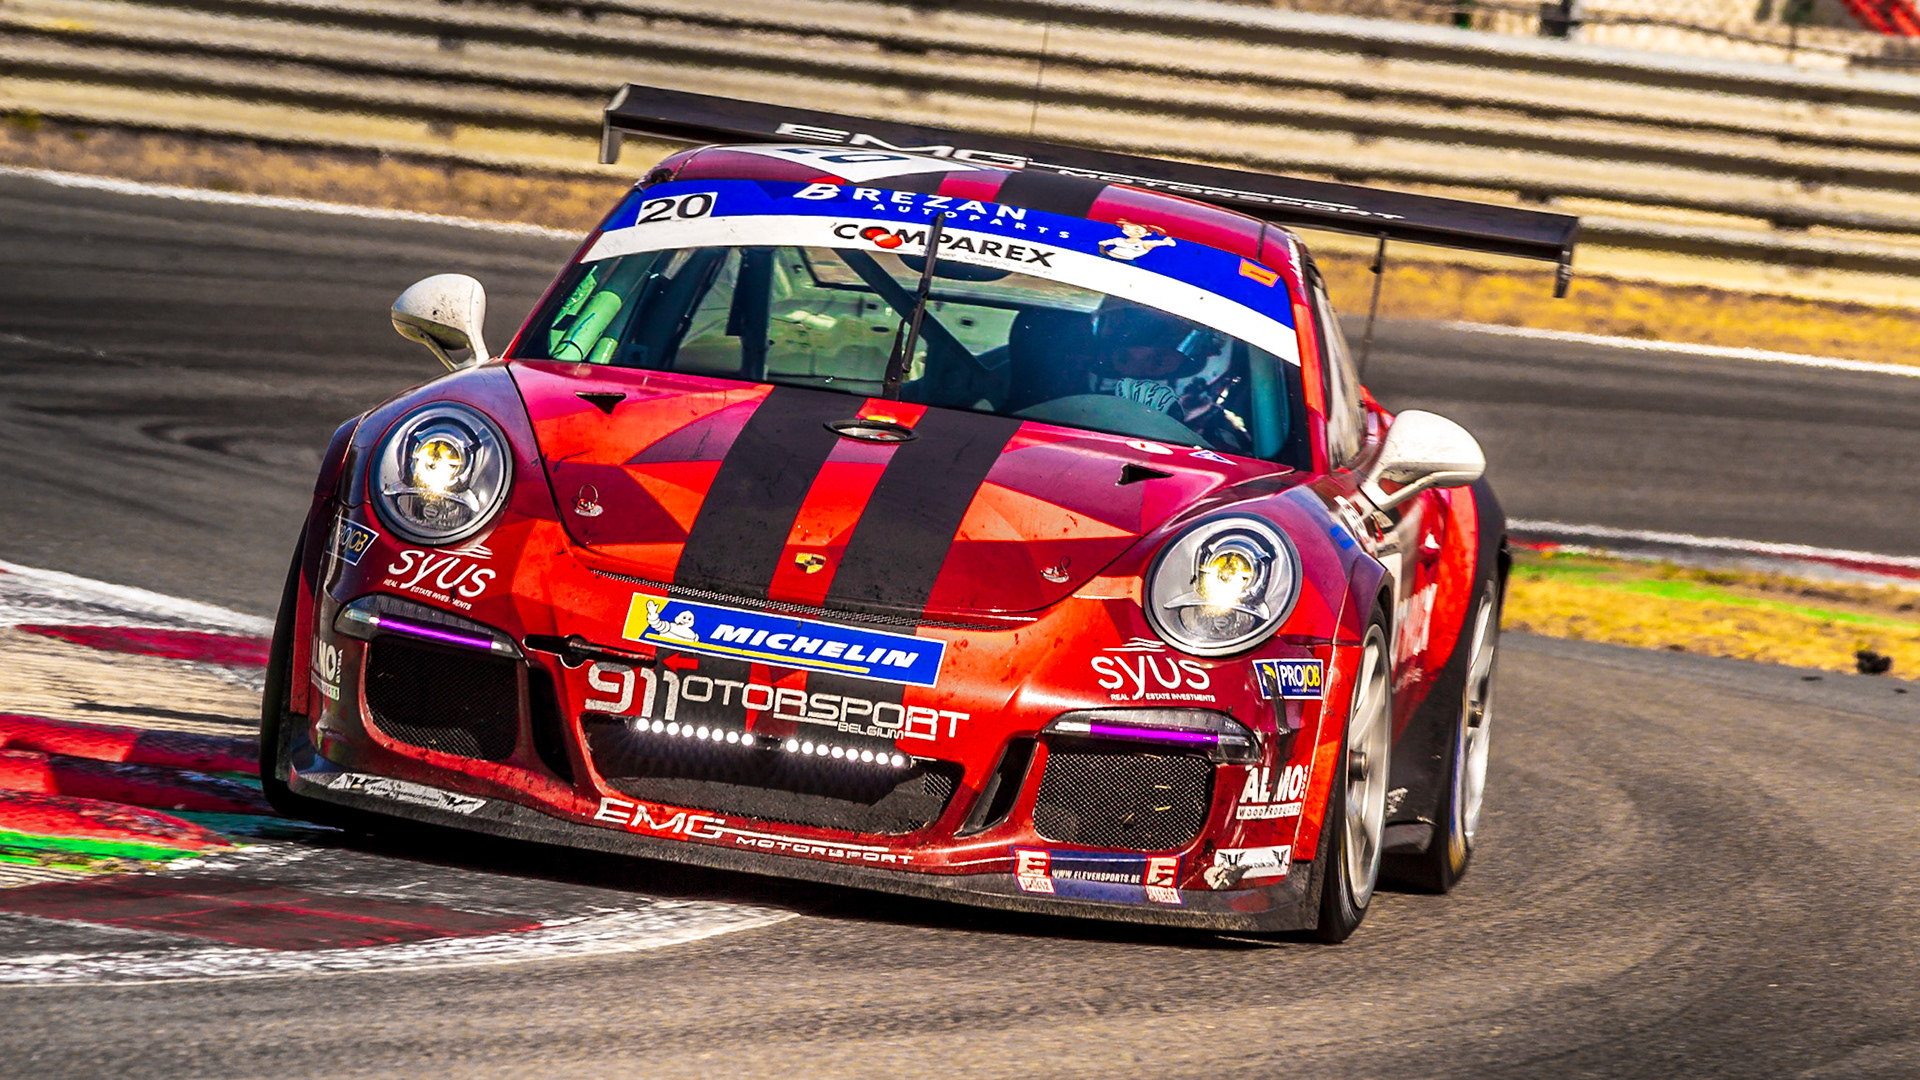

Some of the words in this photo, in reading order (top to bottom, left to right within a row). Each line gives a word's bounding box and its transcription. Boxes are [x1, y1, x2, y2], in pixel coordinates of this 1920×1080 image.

[775, 122, 1030, 169] EMG
[1057, 169, 1406, 219] MOTORSPORT
[638, 193, 713, 225] 20
[792, 182, 1027, 221] BREZAN
[871, 202, 1071, 240] AUTOPARTS
[833, 222, 1057, 268] COMPAREX
[431, 591, 472, 611] INVESMENTS
[709, 623, 920, 669] MICHELIN
[1110, 693, 1130, 701] REAL
[1145, 692, 1171, 701] ESTATE
[1278, 664, 1321, 693] PROJOB
[837, 721, 904, 740] BELGIUM
[594, 797, 726, 839] EMG
[735, 836, 915, 865] MOTORSPORT
